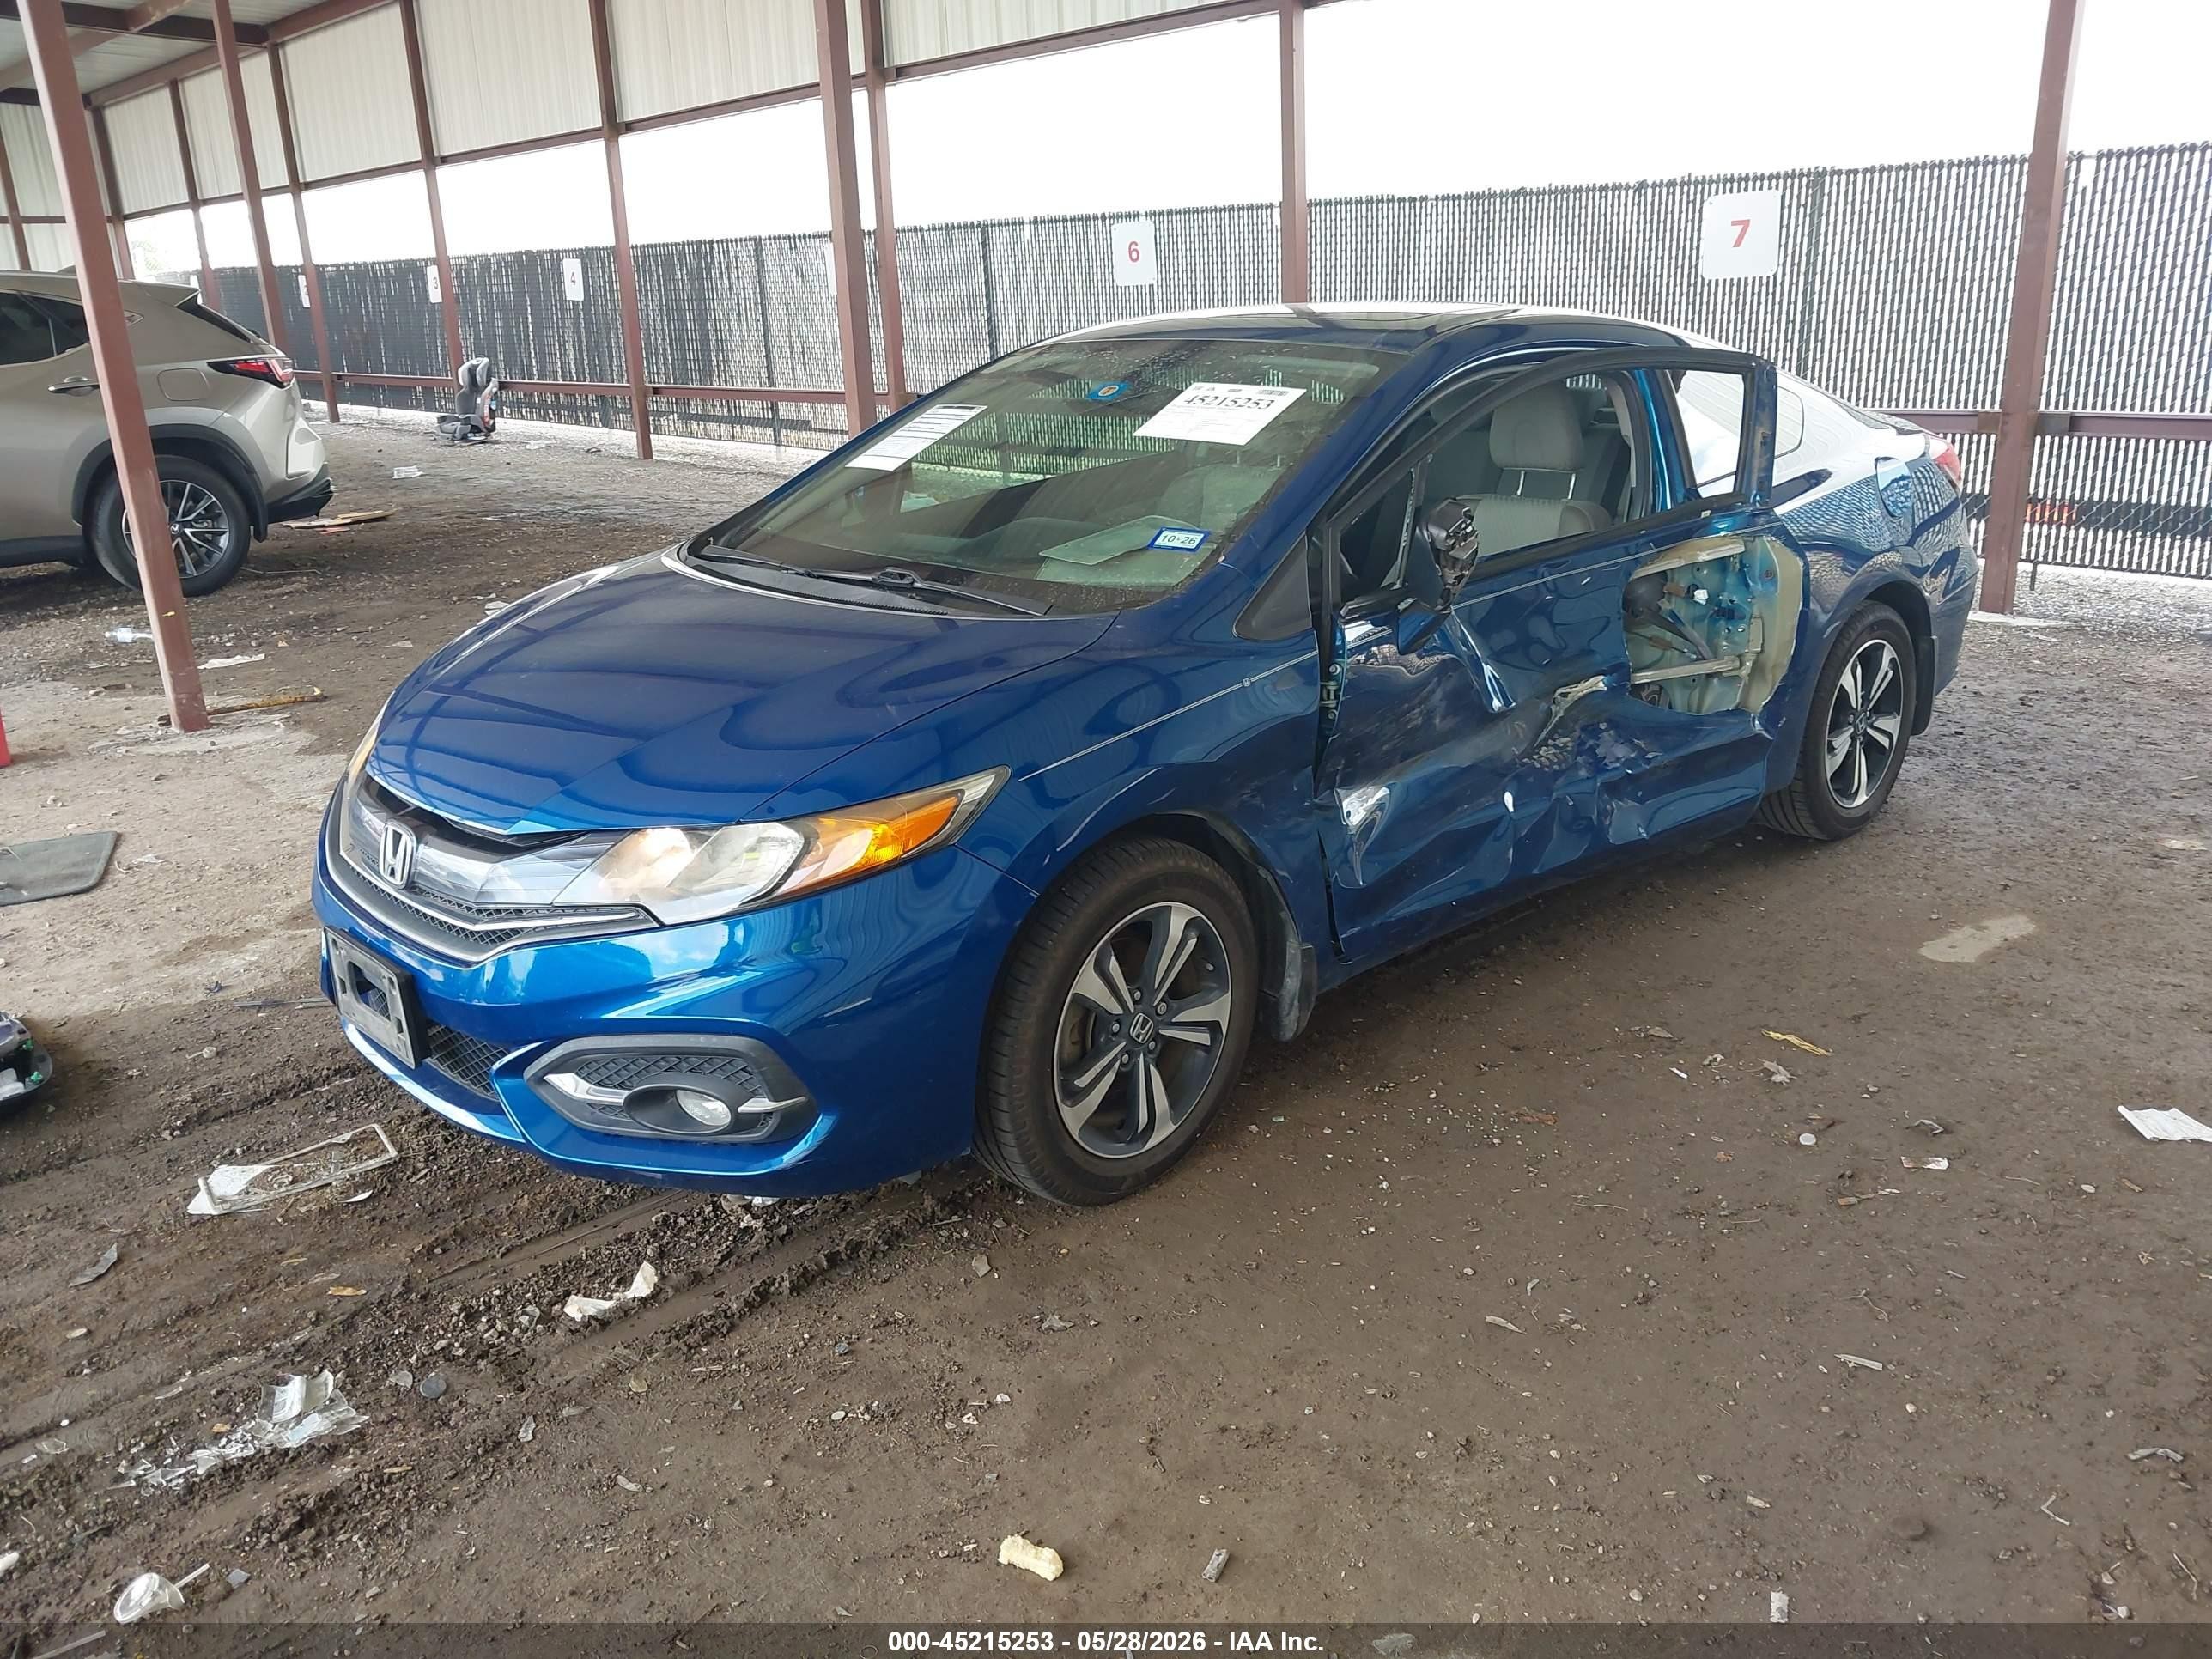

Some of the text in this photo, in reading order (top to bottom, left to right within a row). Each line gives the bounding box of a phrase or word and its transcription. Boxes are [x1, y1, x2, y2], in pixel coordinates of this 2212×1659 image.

[1730, 218, 1751, 248] 7
[1127, 240, 1140, 263] 6
[432, 276, 439, 289] 3
[569, 270, 577, 286] 4
[1182, 394, 1275, 410] 45215253
